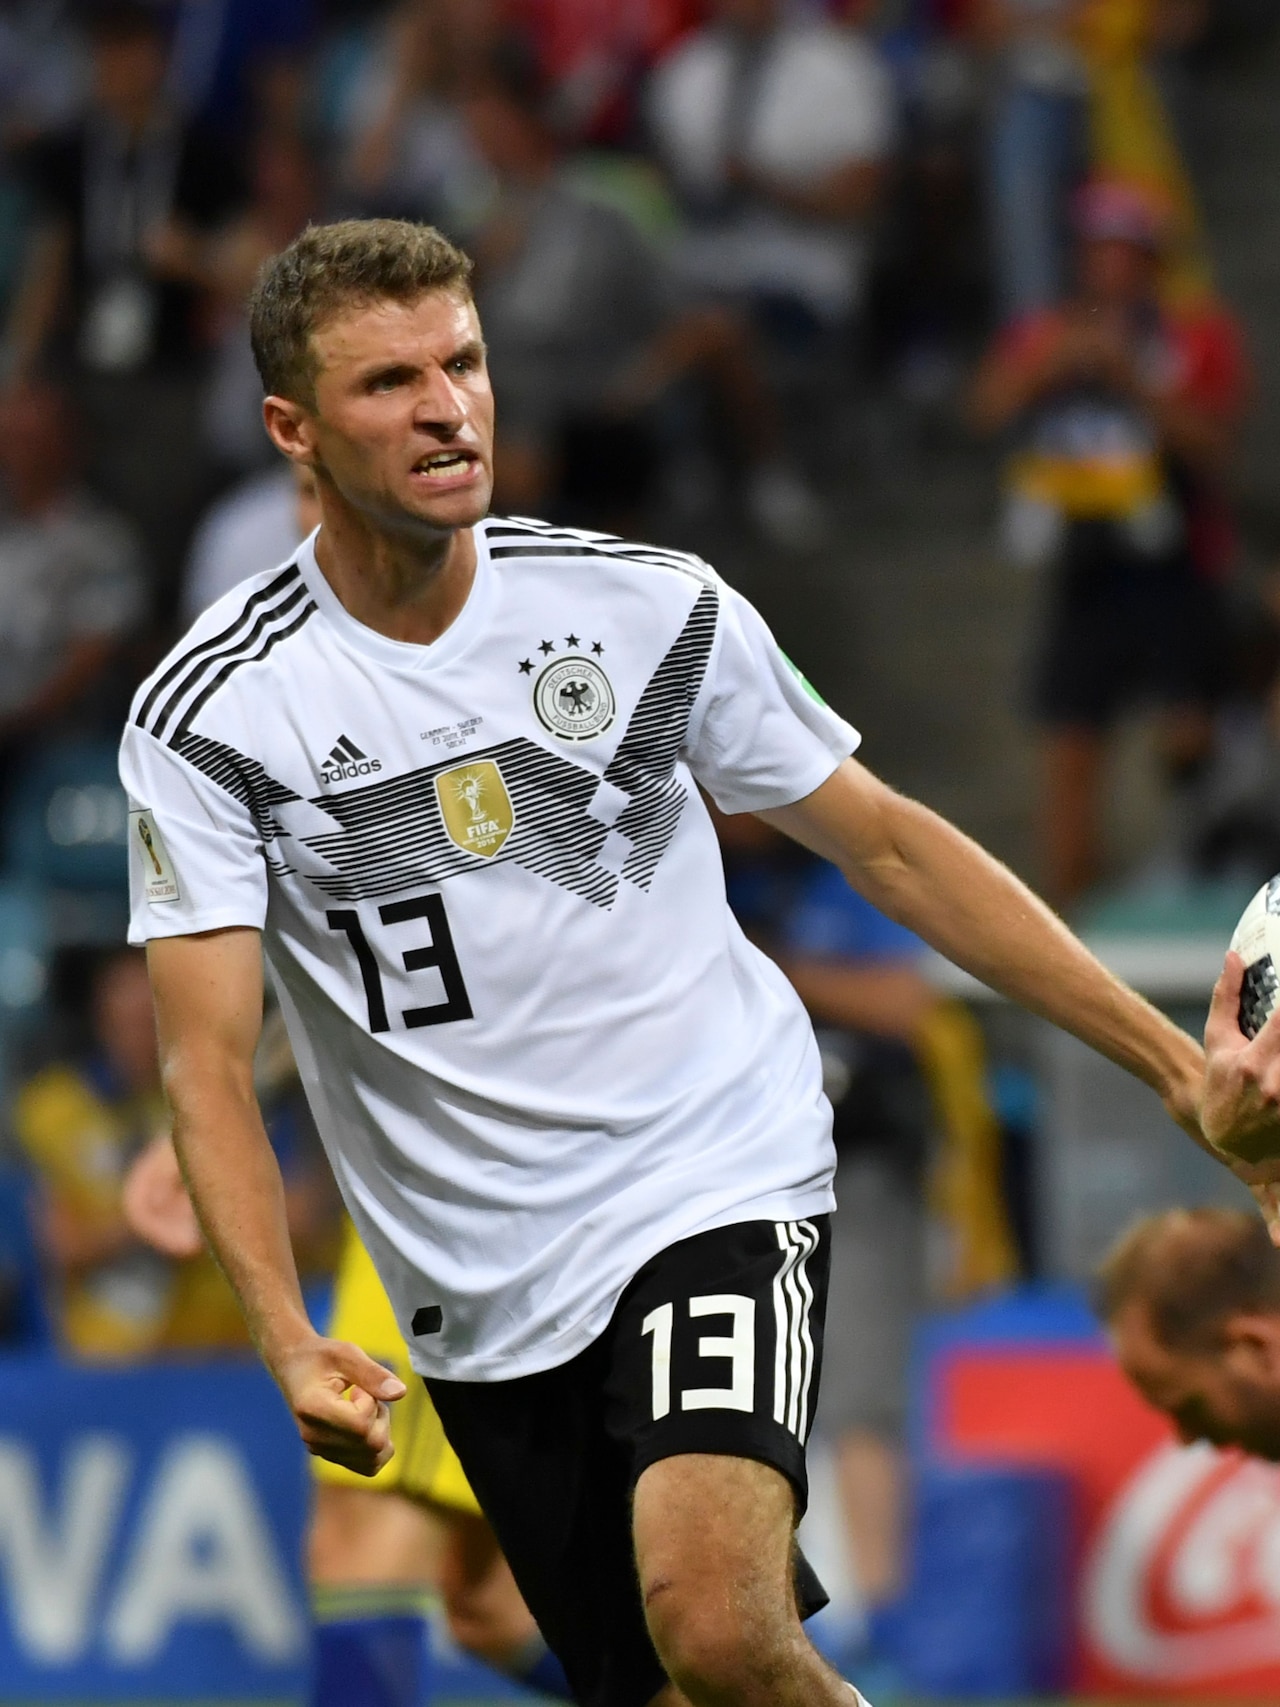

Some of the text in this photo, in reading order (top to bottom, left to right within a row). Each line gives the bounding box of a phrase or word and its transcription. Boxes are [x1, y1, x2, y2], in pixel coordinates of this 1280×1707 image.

[548, 667, 593, 689] DEUTSCHER
[320, 758, 382, 785] adidas
[466, 820, 499, 838] FIFA
[477, 837, 496, 848] 2014
[326, 892, 474, 1034] 13
[641, 1294, 756, 1422] 13
